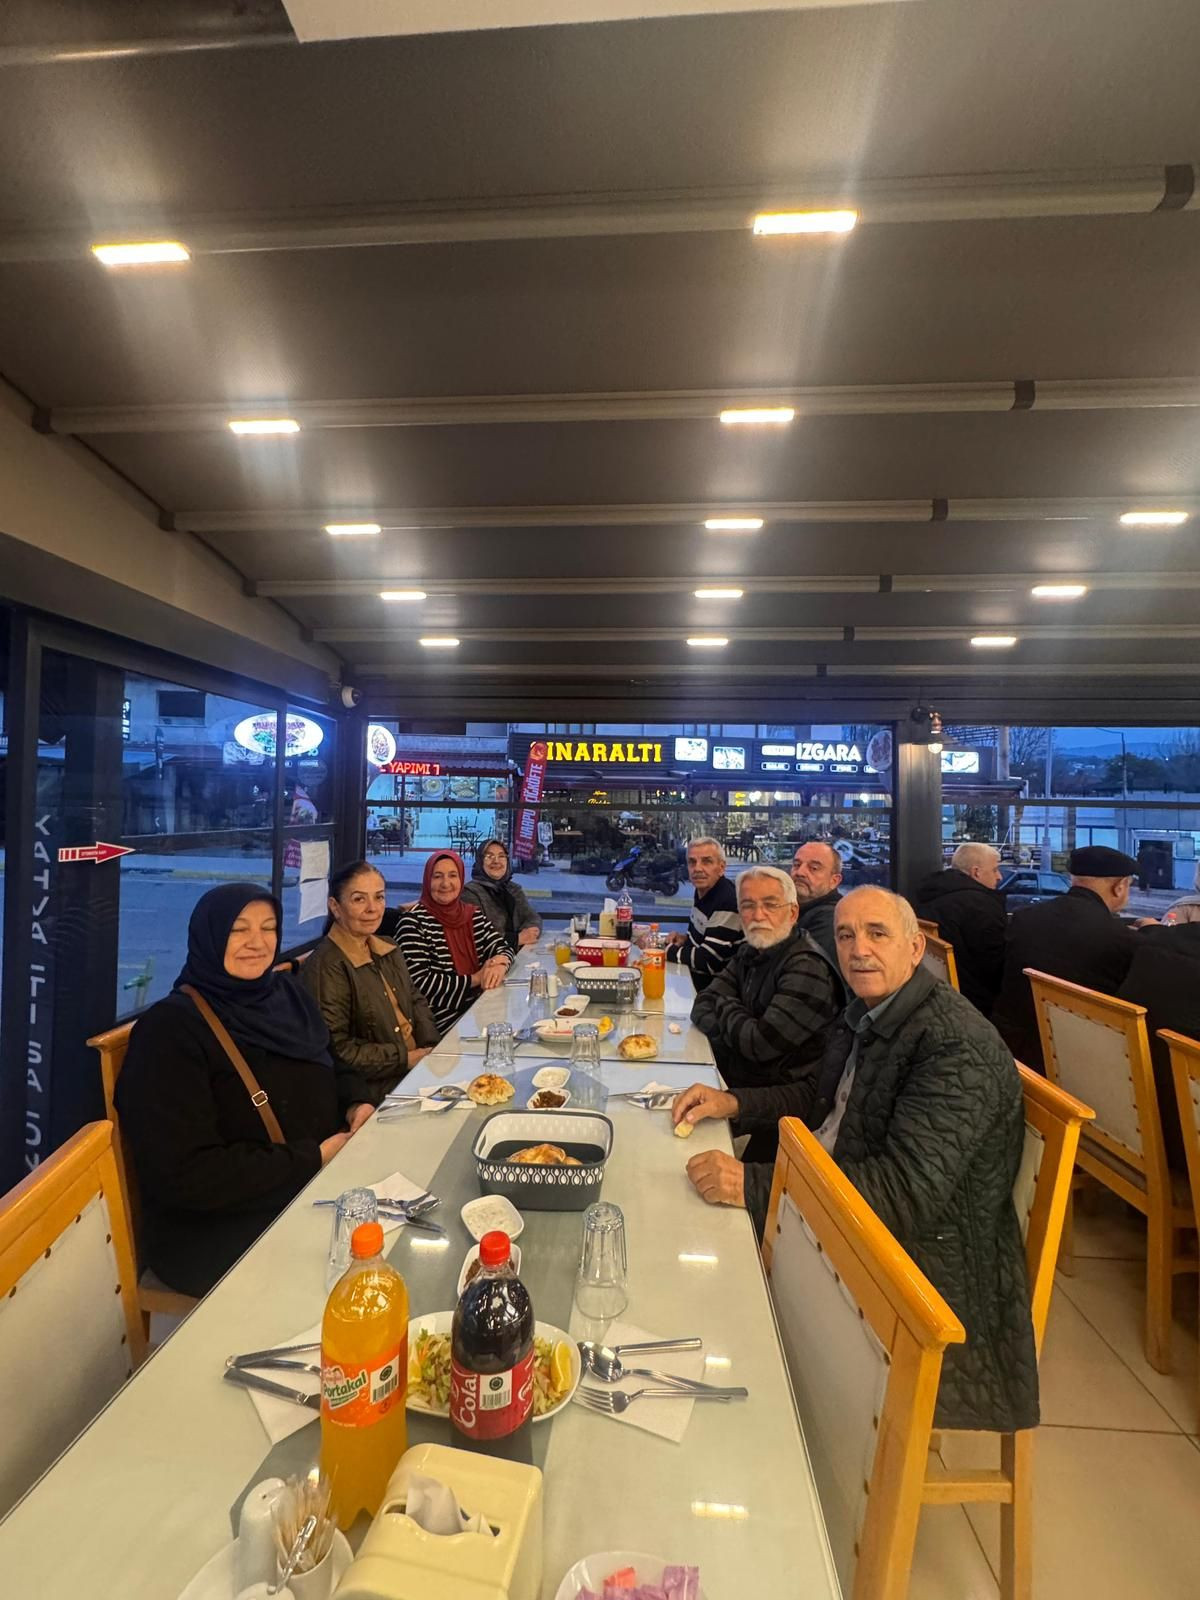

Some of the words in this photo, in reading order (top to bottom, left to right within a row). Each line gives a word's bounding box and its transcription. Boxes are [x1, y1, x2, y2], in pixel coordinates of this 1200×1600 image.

[530, 741, 662, 762] INARALTI
[796, 742, 862, 762] IZGARA
[389, 761, 430, 775] YAPIMI
[520, 808, 536, 840] HARPU
[323, 1370, 367, 1398] Portakal
[460, 1374, 478, 1428] Cola
